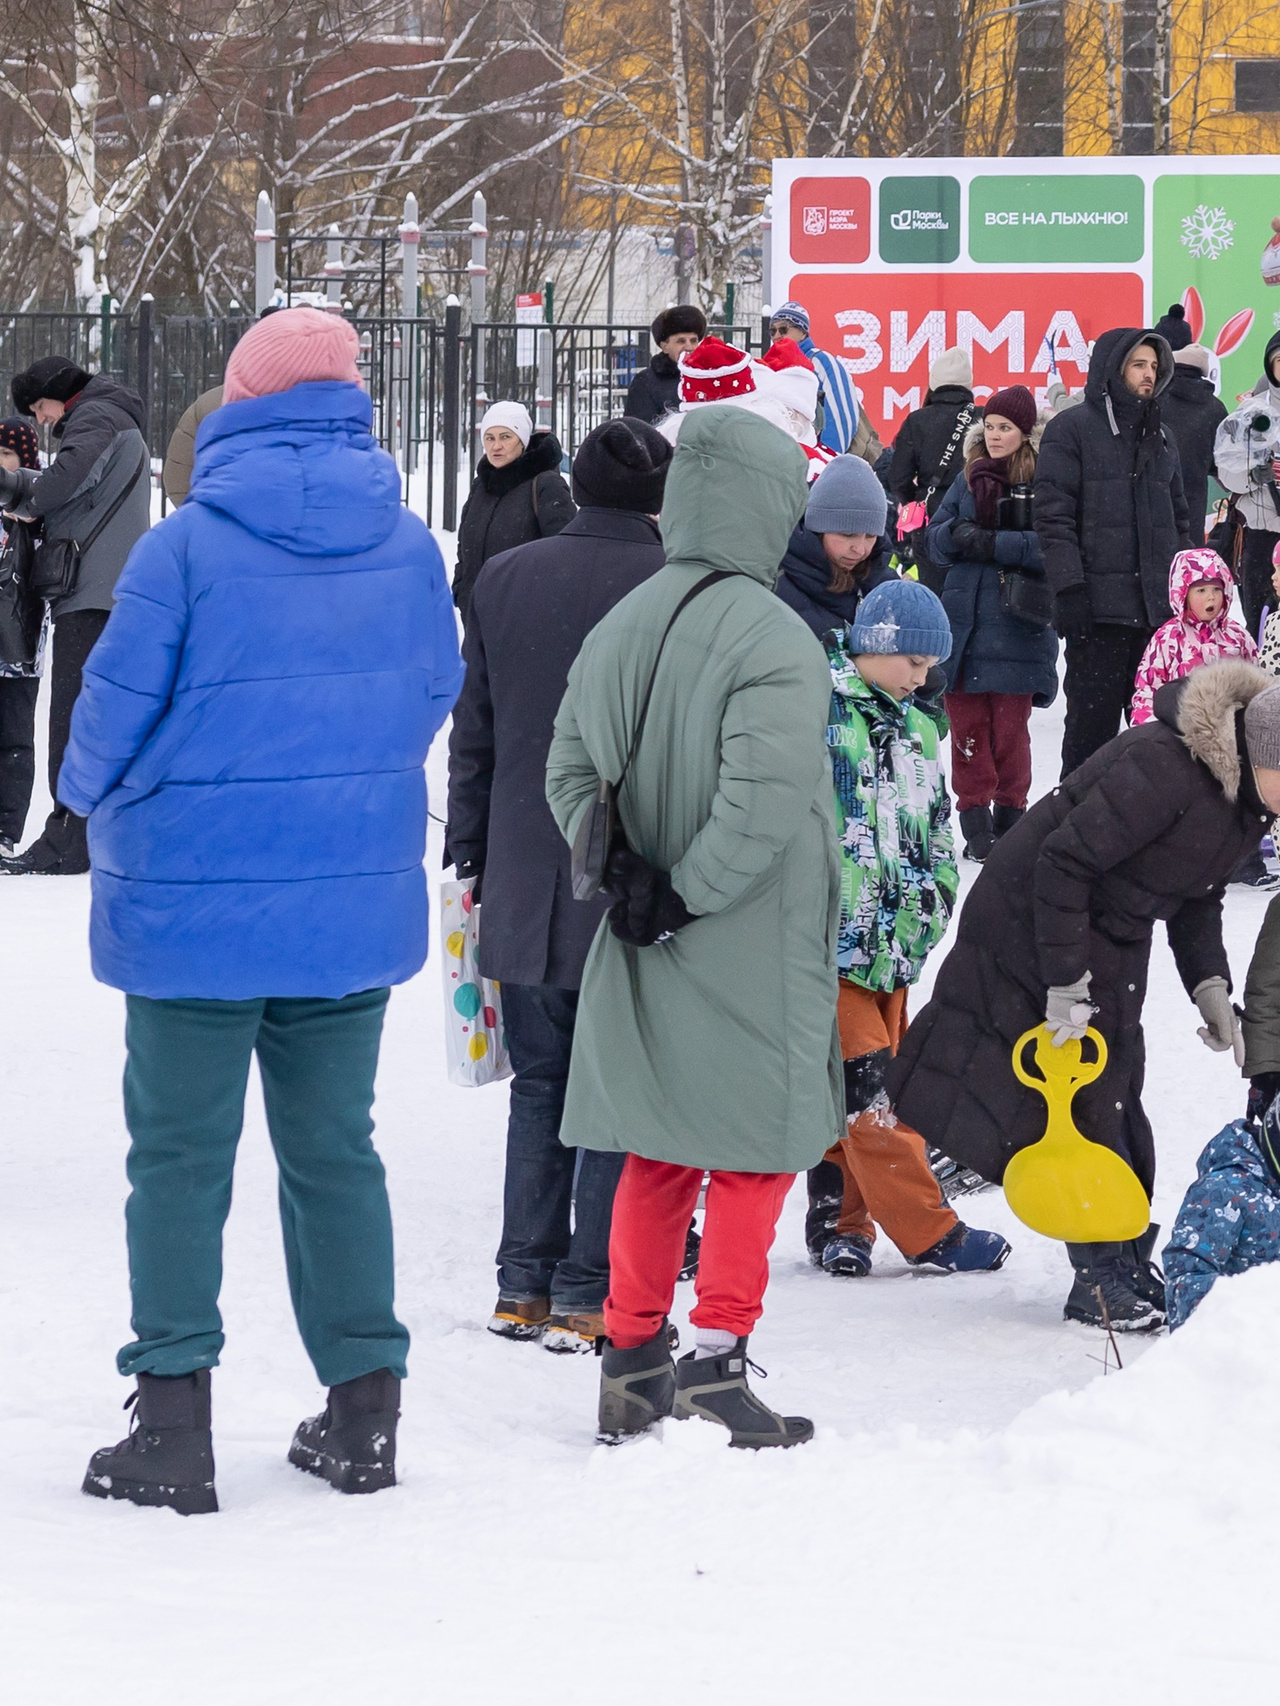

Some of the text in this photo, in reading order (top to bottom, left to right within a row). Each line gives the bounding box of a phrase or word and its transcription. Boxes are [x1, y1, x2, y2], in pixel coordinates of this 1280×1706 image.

[912, 210, 942, 221] Парки
[985, 211, 1128, 225] ВСЕ НА ЛЫЖНЮ!
[912, 219, 949, 230] Москвы
[834, 309, 1091, 374] ЗИМА
